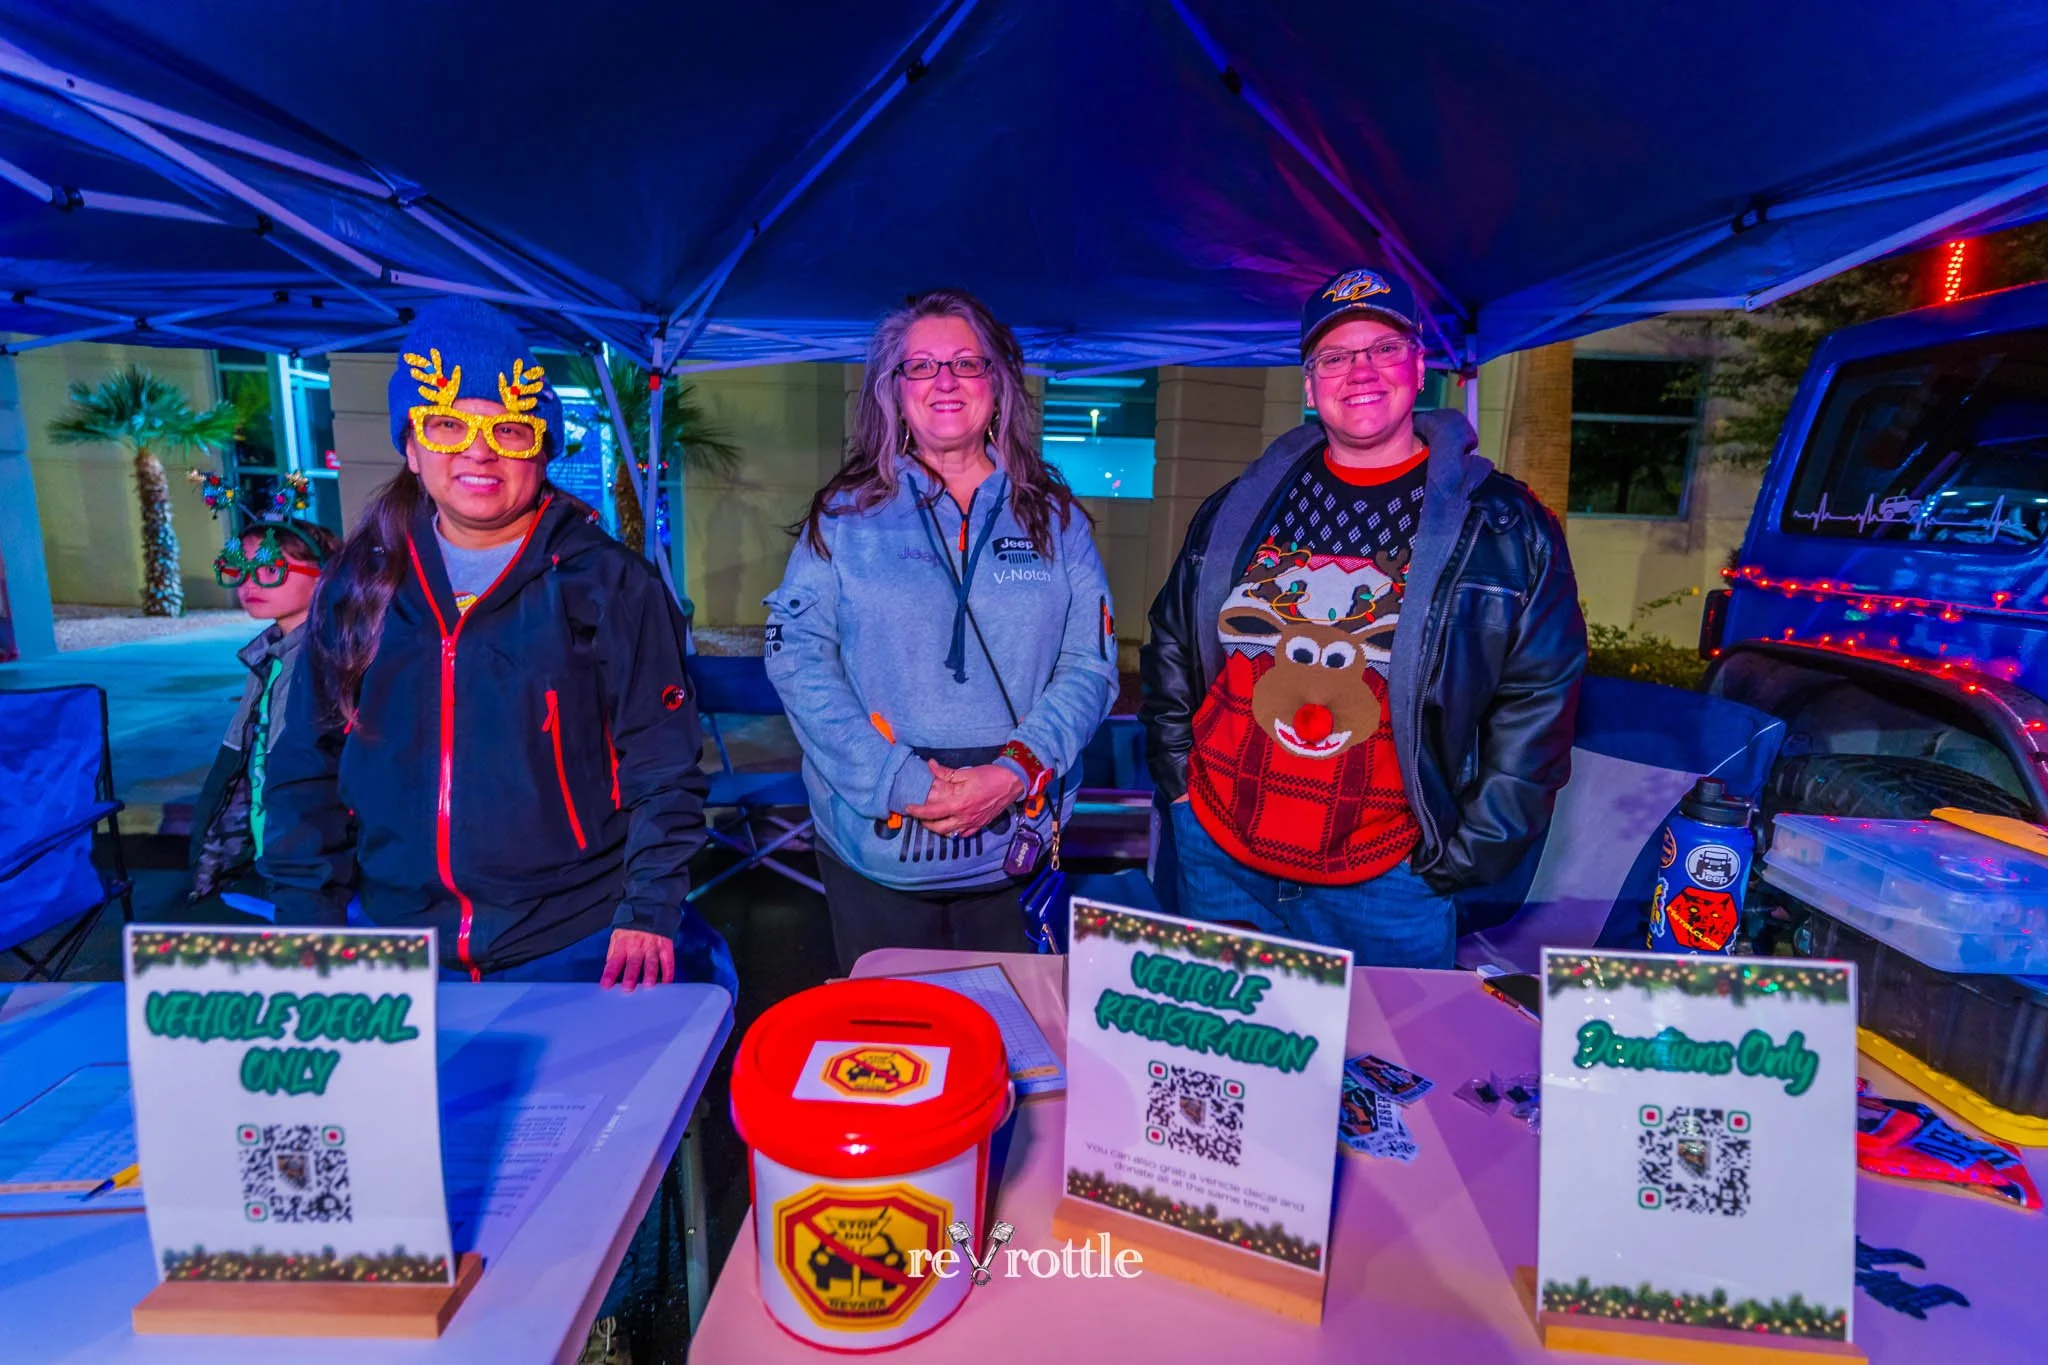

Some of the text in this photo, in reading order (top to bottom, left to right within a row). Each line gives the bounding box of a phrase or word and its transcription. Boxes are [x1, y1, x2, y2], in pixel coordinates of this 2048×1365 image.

[1001, 538, 1033, 550] Jeep
[994, 568, 1051, 584] V-Notch
[1696, 872, 1728, 885] Jeep
[1131, 951, 1272, 1015] VEHICLE
[145, 990, 419, 1043] VEHICLE DECAL
[1094, 988, 1319, 1074] REGISTRATION
[240, 1046, 341, 1096] ONLY
[1573, 1019, 1819, 1096] Donations Only
[1085, 1141, 1305, 1213] You can also grab a vehicle decal and
[1114, 1161, 1154, 1179] donate
[1171, 1177, 1183, 1189] at
[1186, 1181, 1205, 1196] the
[1207, 1189, 1240, 1205] same
[1243, 1196, 1271, 1213] time
